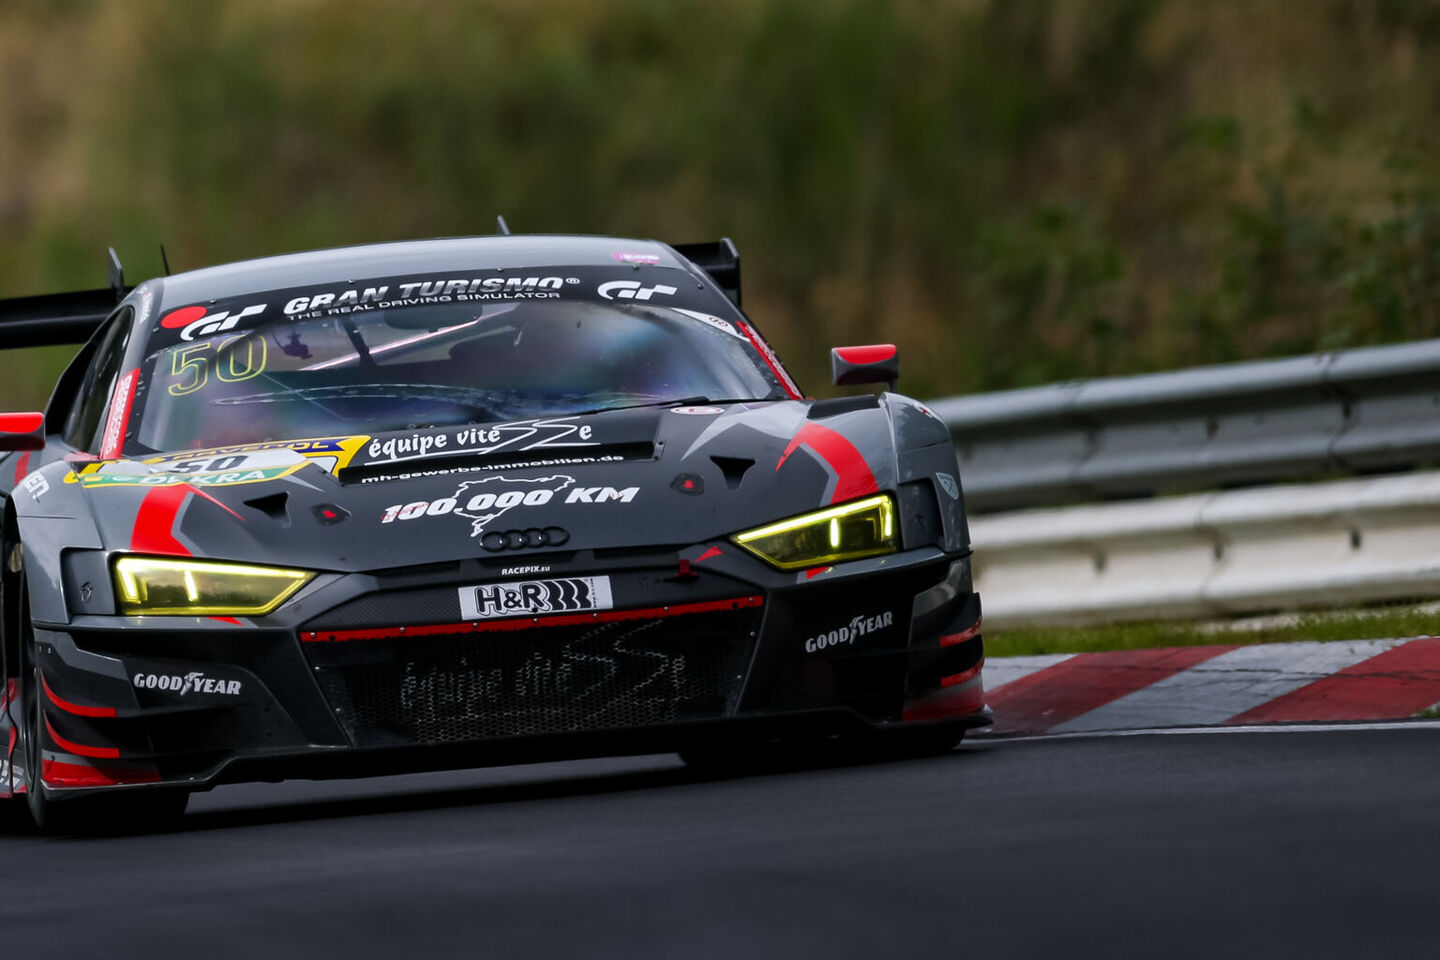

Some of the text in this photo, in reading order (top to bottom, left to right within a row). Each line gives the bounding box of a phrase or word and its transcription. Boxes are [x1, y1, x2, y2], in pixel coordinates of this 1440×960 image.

[283, 286, 388, 315] GRAN
[287, 291, 561, 321] THE REAL DRIVING SIMULATOR
[168, 334, 268, 396] 50
[368, 432, 448, 460] équipe
[168, 455, 249, 473] 50
[381, 487, 641, 524] 100.000 KM
[501, 565, 551, 576] RACEPIX.EU
[474, 581, 551, 617] H&R
